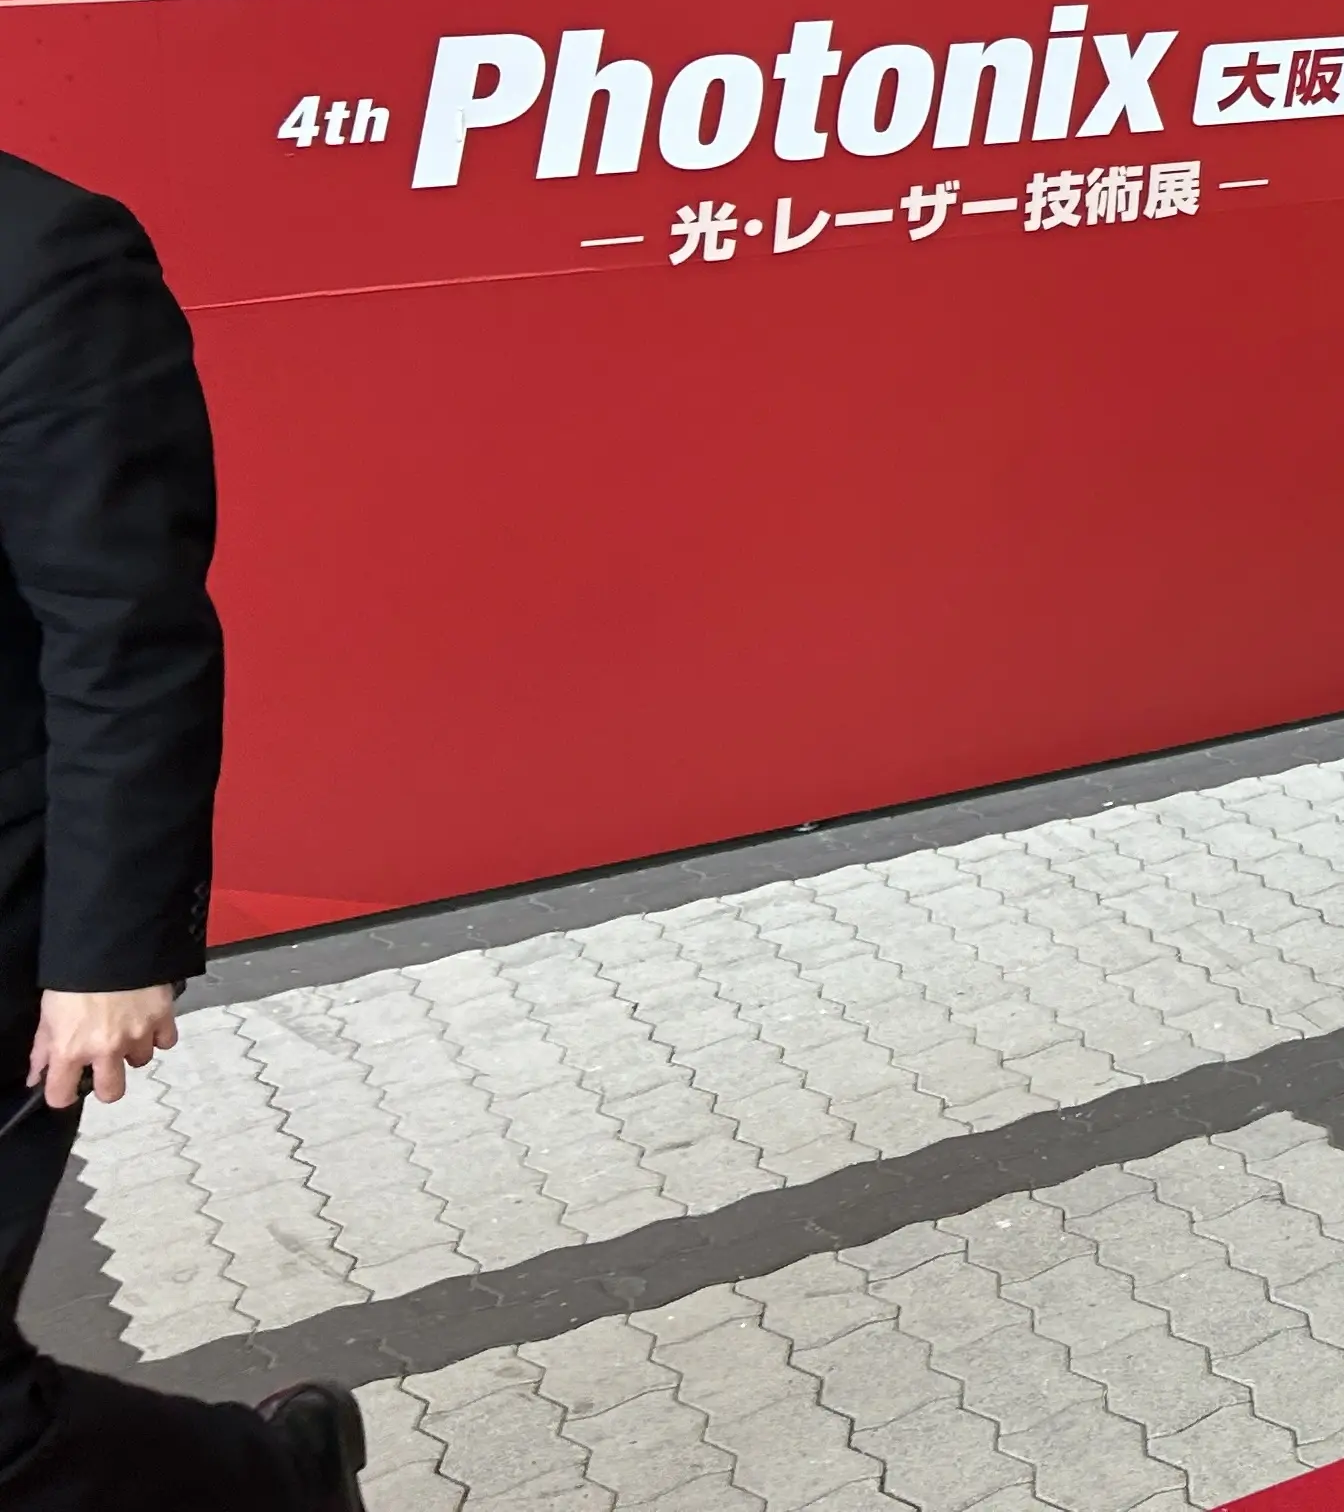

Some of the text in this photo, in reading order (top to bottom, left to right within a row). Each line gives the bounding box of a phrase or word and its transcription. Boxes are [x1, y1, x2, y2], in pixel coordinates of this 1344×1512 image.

[278, 95, 390, 148] 4th
[412, 5, 1179, 189] Photonix
[669, 160, 1201, 265] 光・レーザー技術展
